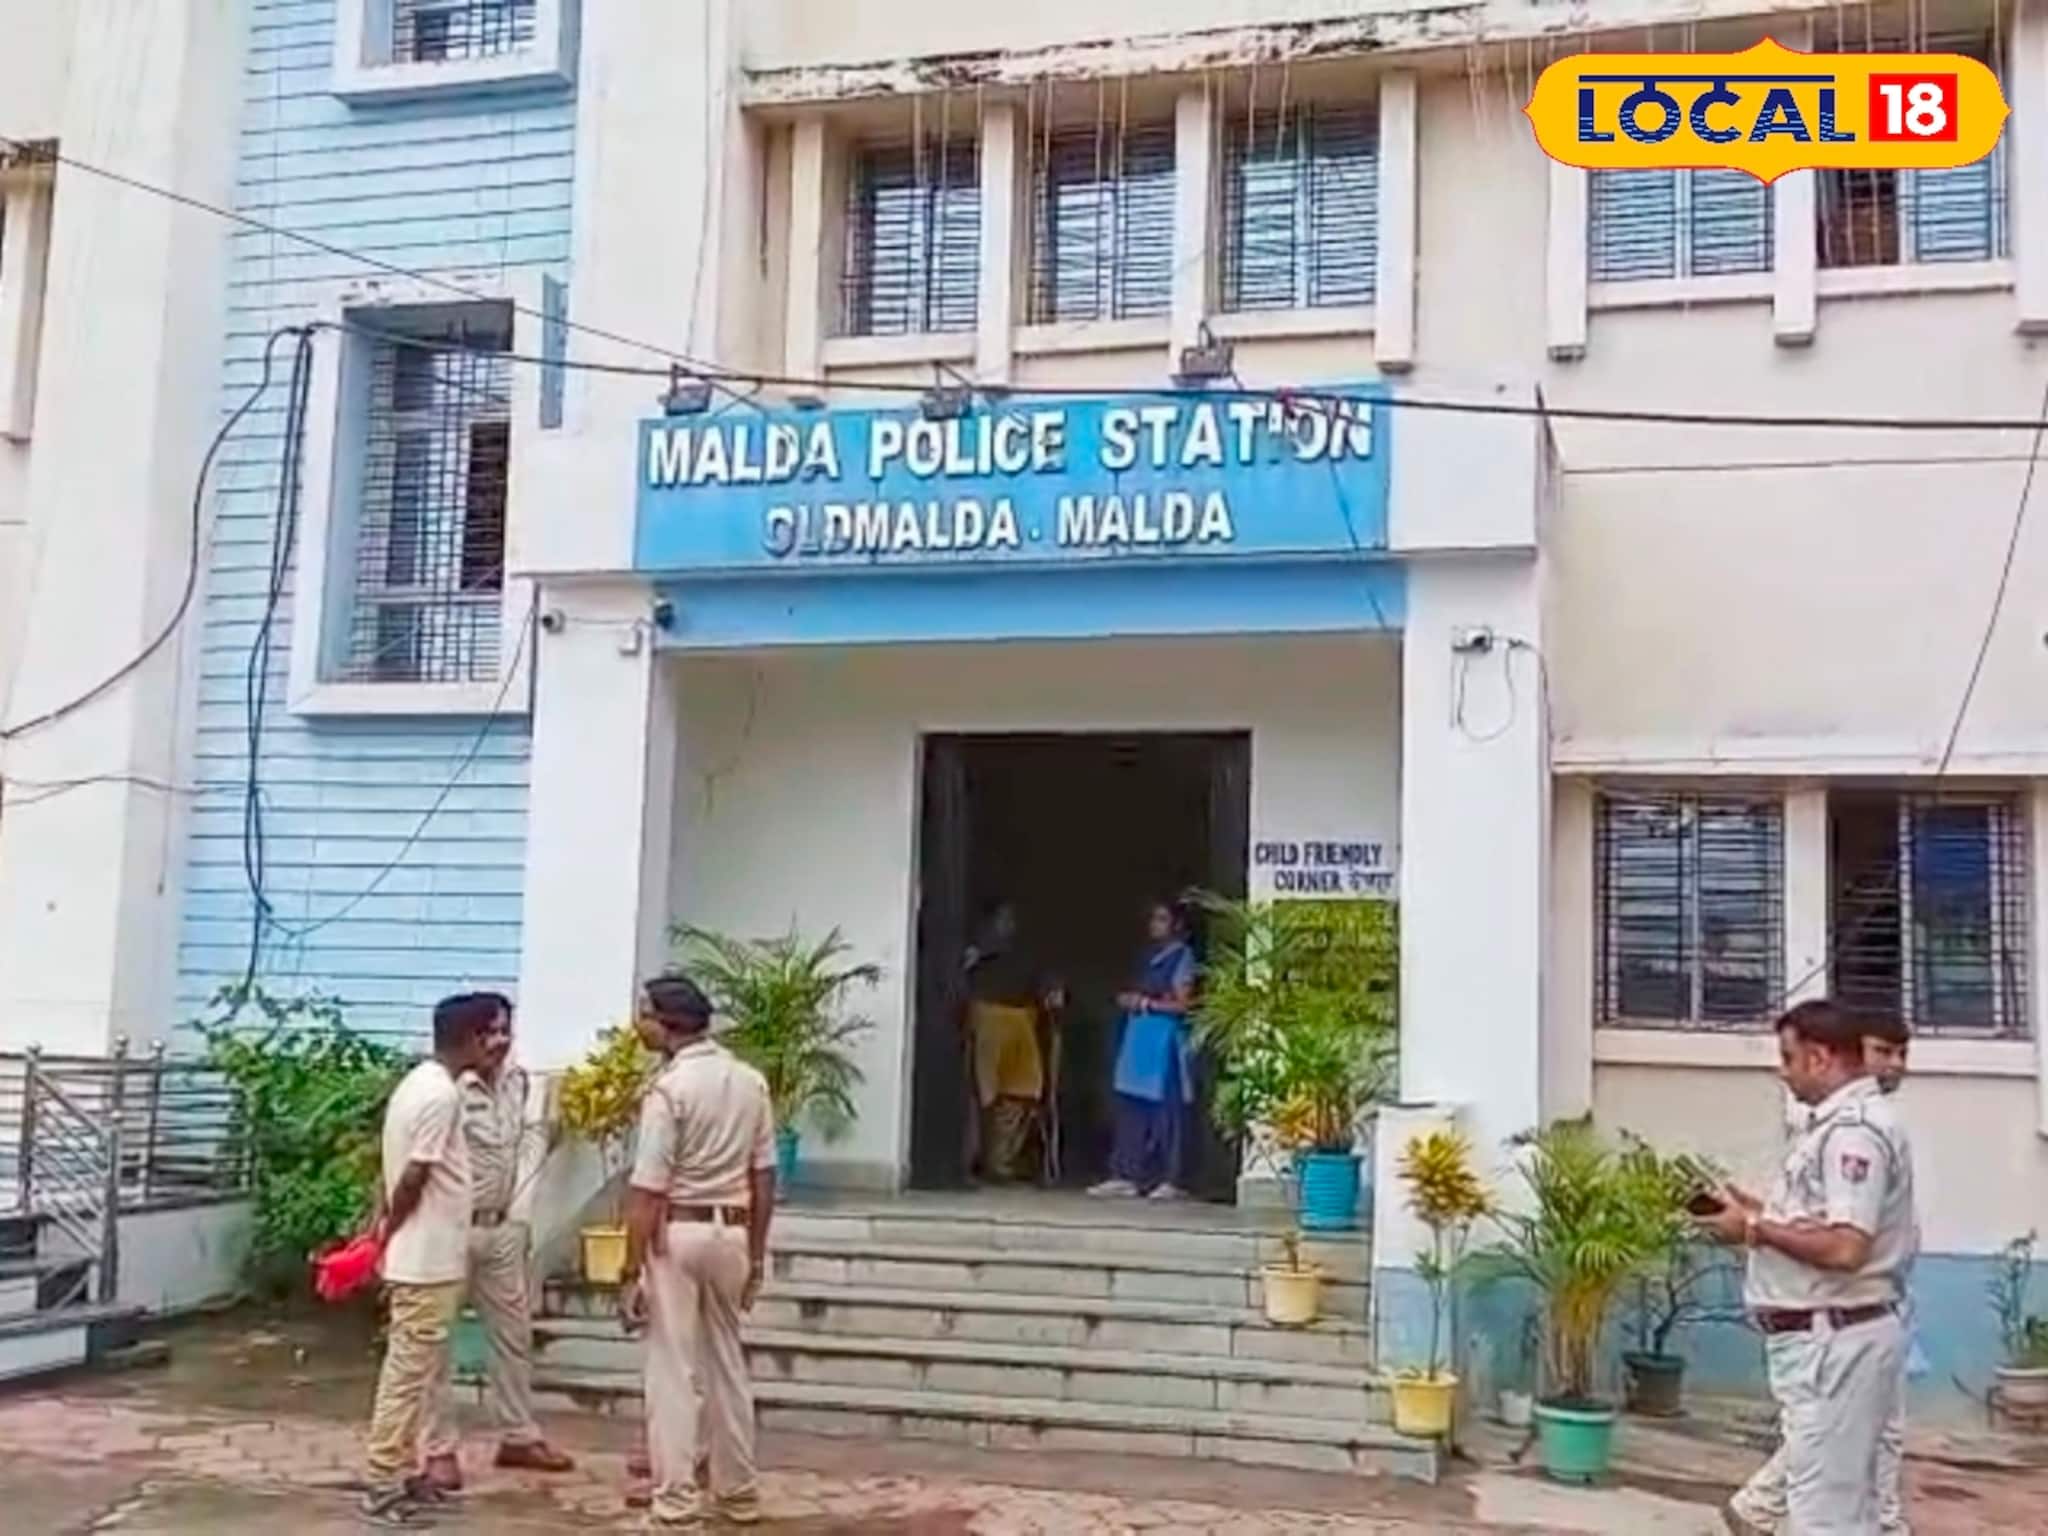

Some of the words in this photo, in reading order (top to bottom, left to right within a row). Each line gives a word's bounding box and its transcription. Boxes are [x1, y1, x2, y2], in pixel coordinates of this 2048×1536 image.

[648, 419, 840, 487] MALDA
[868, 411, 1066, 479] POLICE
[1057, 491, 1233, 548] MALDA
[1255, 842, 1299, 866] CHILD
[1303, 842, 1382, 866] FRIENDLY
